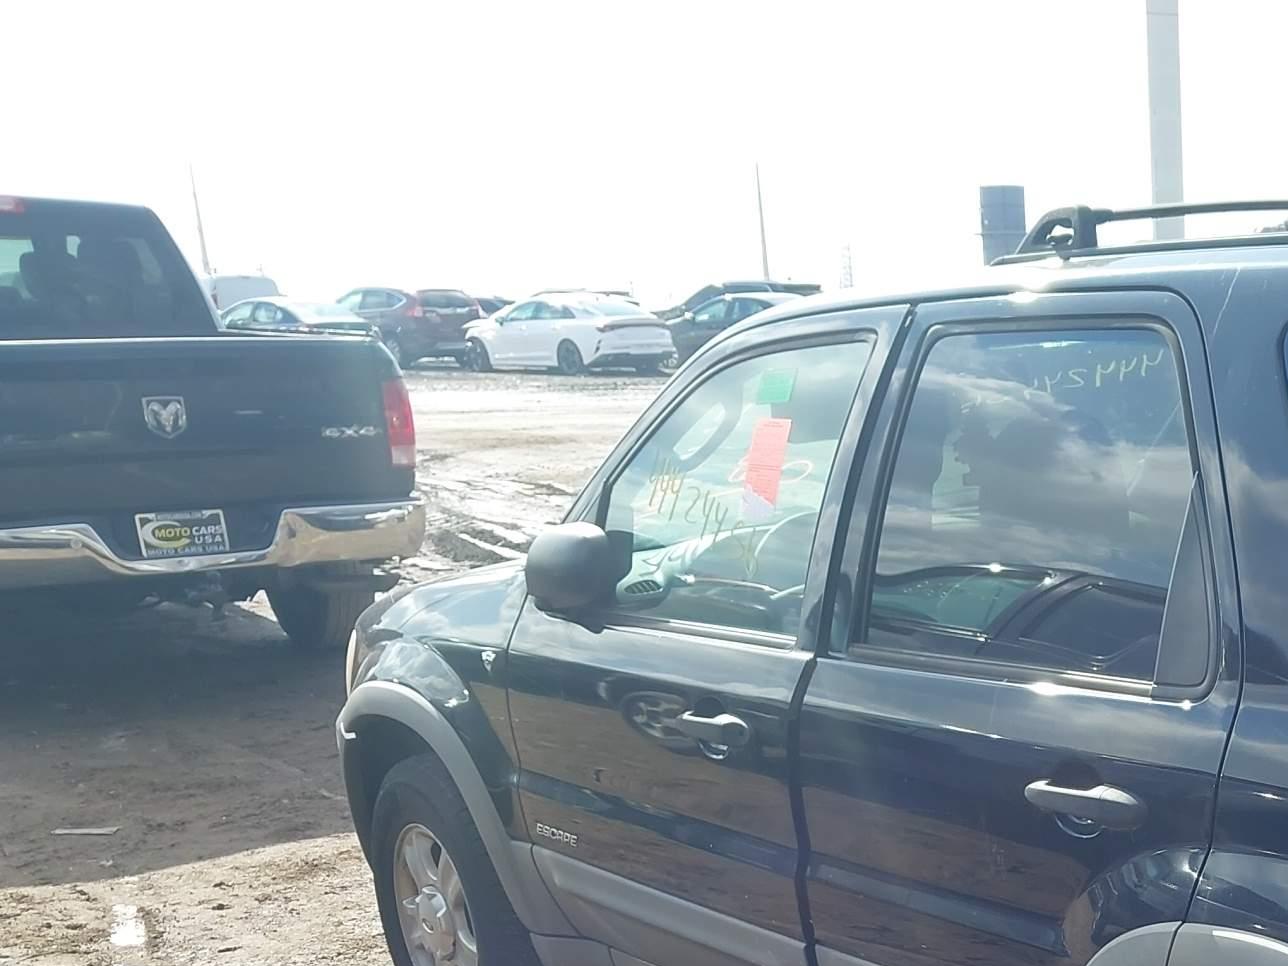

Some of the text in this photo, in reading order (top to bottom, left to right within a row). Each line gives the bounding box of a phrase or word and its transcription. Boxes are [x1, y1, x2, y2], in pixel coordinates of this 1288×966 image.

[155, 524, 223, 539] MOTO CARS
[194, 534, 223, 545] USA
[536, 822, 578, 848] ESCAPE
